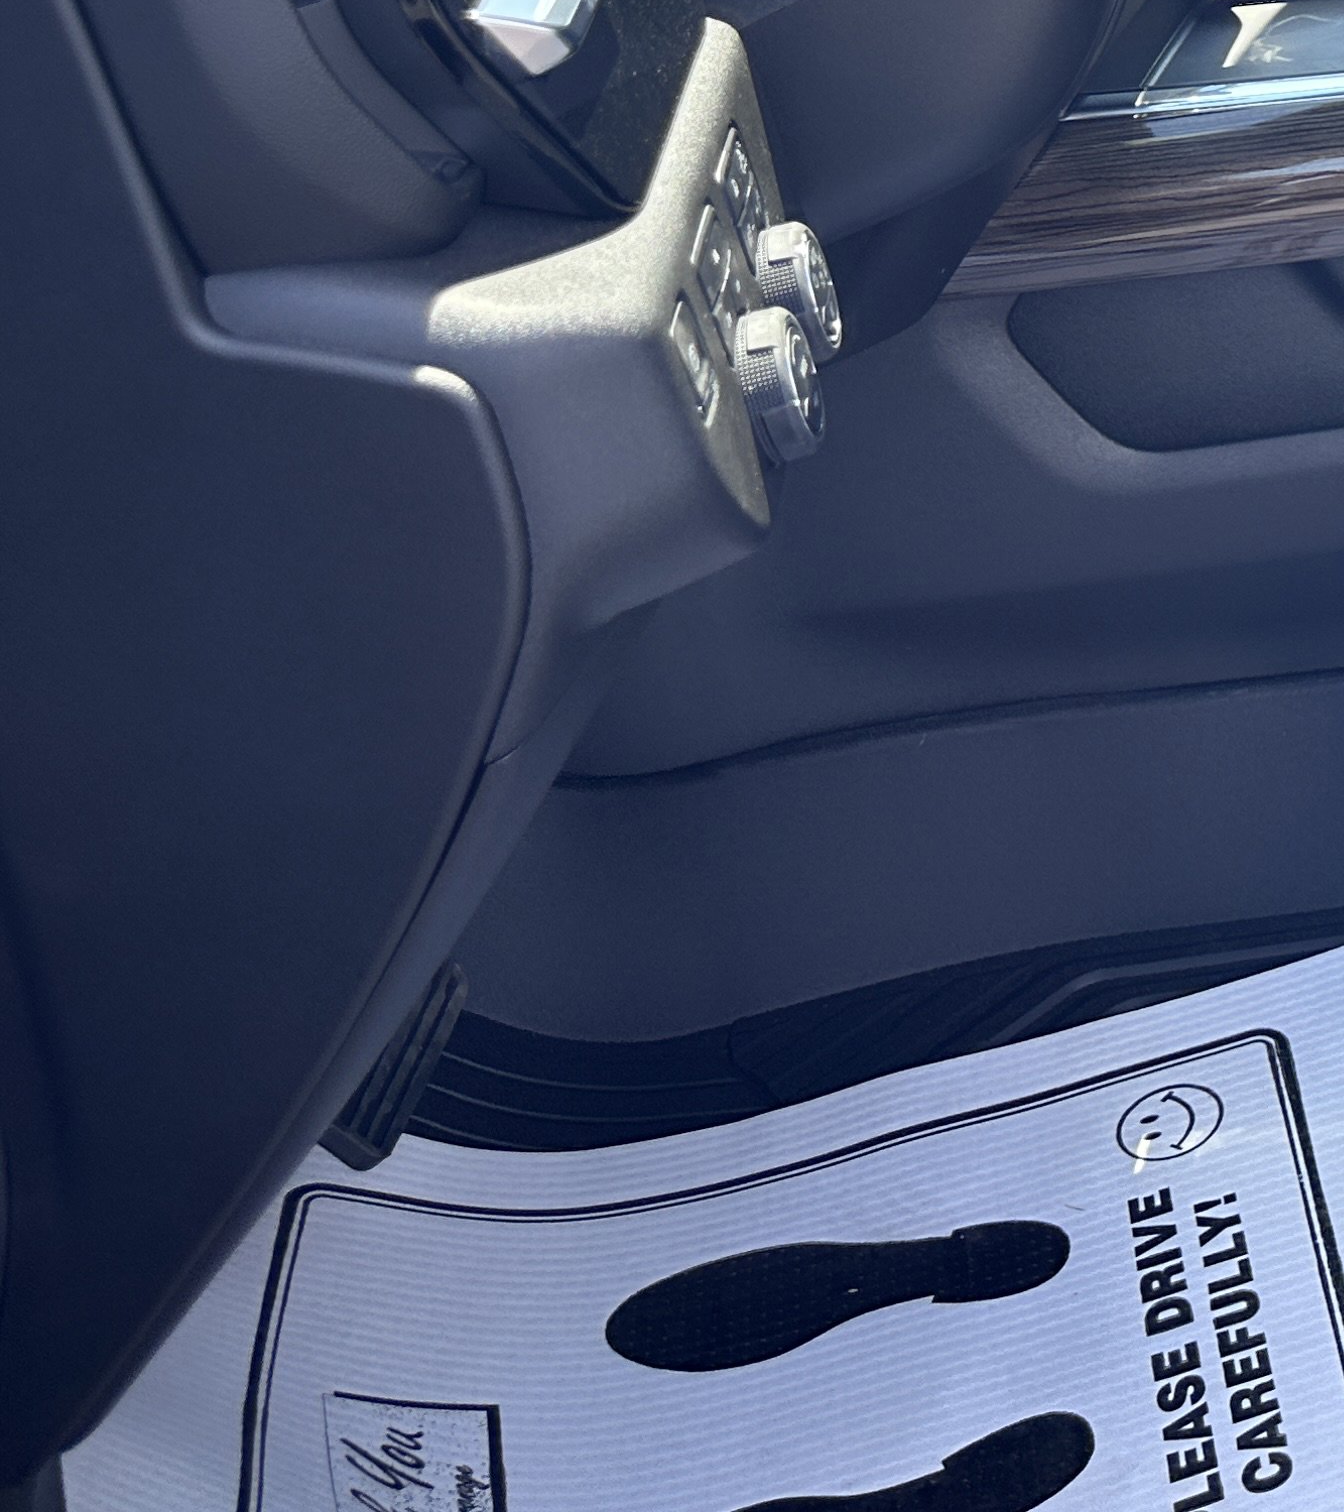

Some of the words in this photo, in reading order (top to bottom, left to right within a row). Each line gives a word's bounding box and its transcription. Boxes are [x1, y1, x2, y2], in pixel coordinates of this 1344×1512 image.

[1128, 1187, 1195, 1337] DRIVE
[1194, 1192, 1293, 1494] CAREFULLY!
[340, 1427, 435, 1490] You
[1151, 1341, 1225, 1512] LEASE
